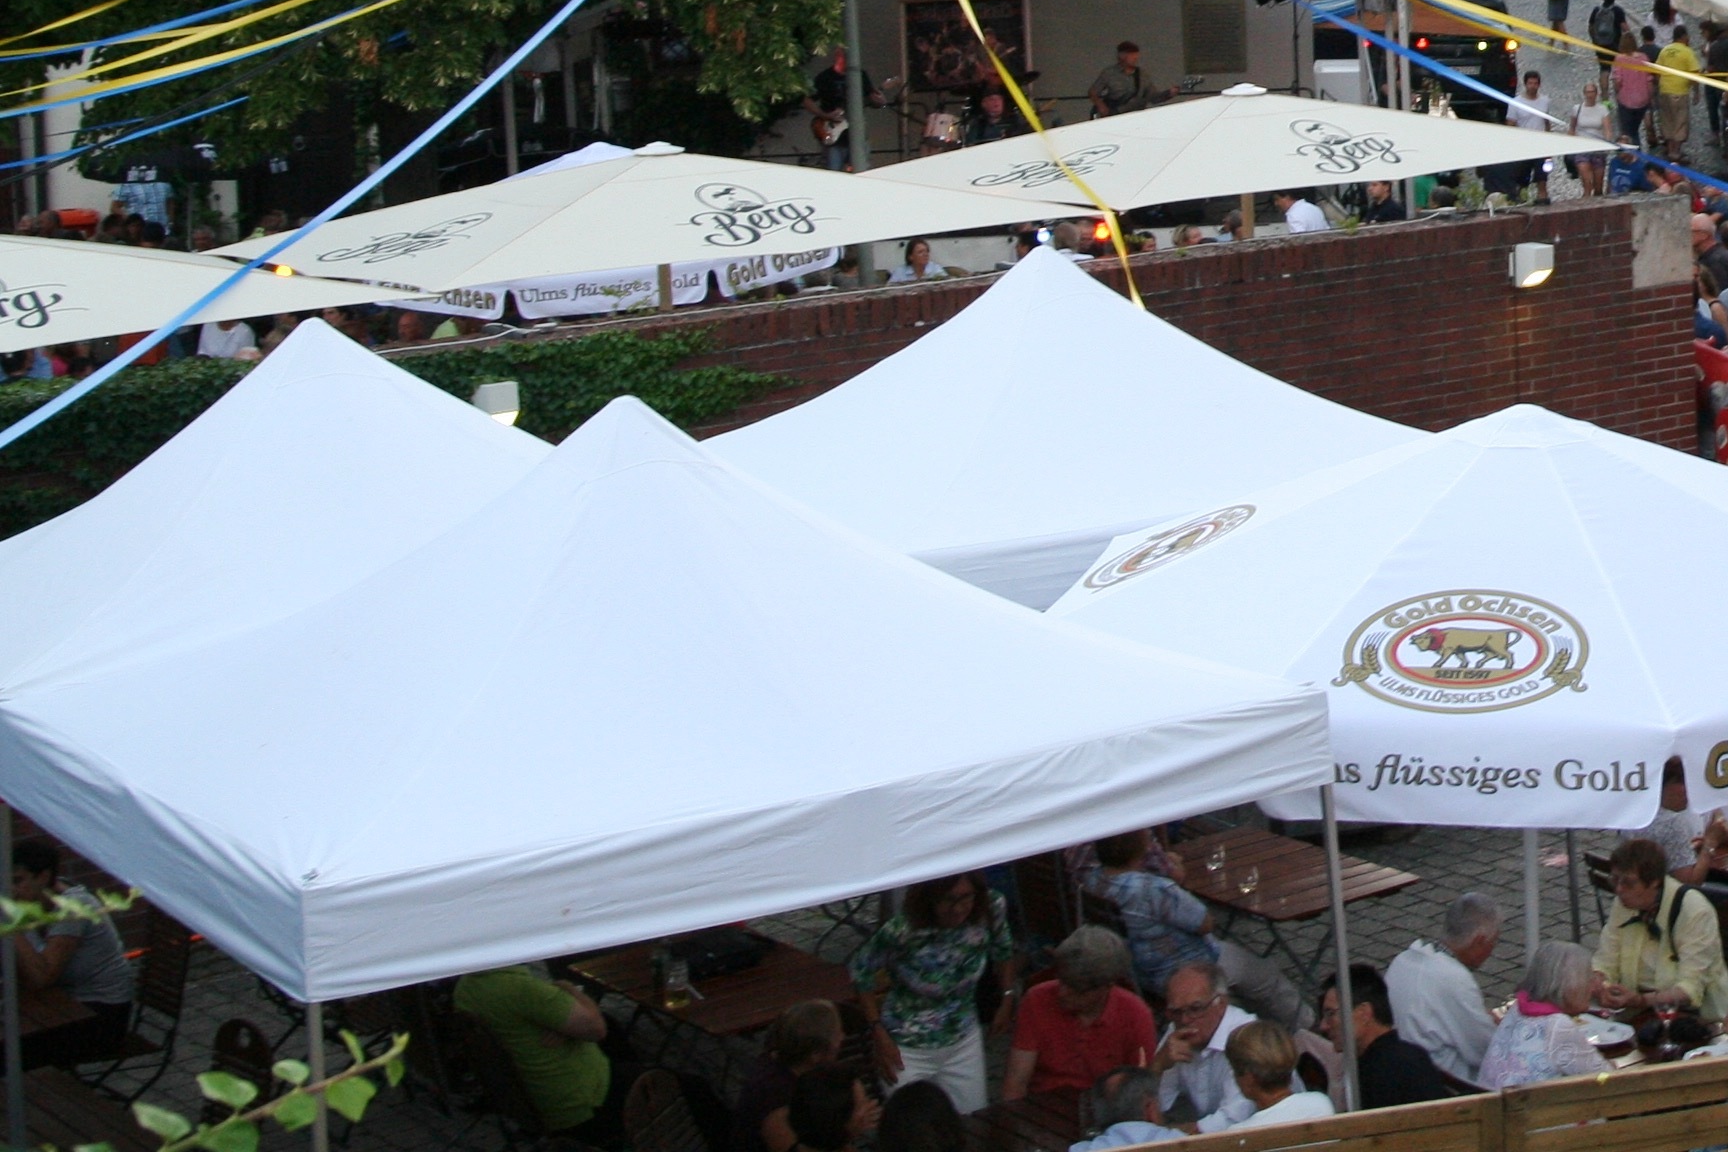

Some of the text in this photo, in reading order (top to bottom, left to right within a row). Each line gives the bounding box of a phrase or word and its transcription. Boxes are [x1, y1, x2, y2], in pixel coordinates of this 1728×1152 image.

[1296, 137, 1402, 174] Berg
[690, 202, 816, 247] Berg
[726, 255, 767, 286] Gold
[440, 288, 496, 310] chsen
[518, 287, 569, 303] Ulms
[672, 273, 700, 289] old
[1383, 595, 1563, 635] Gold Ochsen
[1435, 669, 1462, 679] SEIT
[1378, 677, 1540, 704] ULMS FLÜSSIGES GOLD
[1367, 753, 1541, 795] flüssiges
[1553, 758, 1649, 792] Gold
